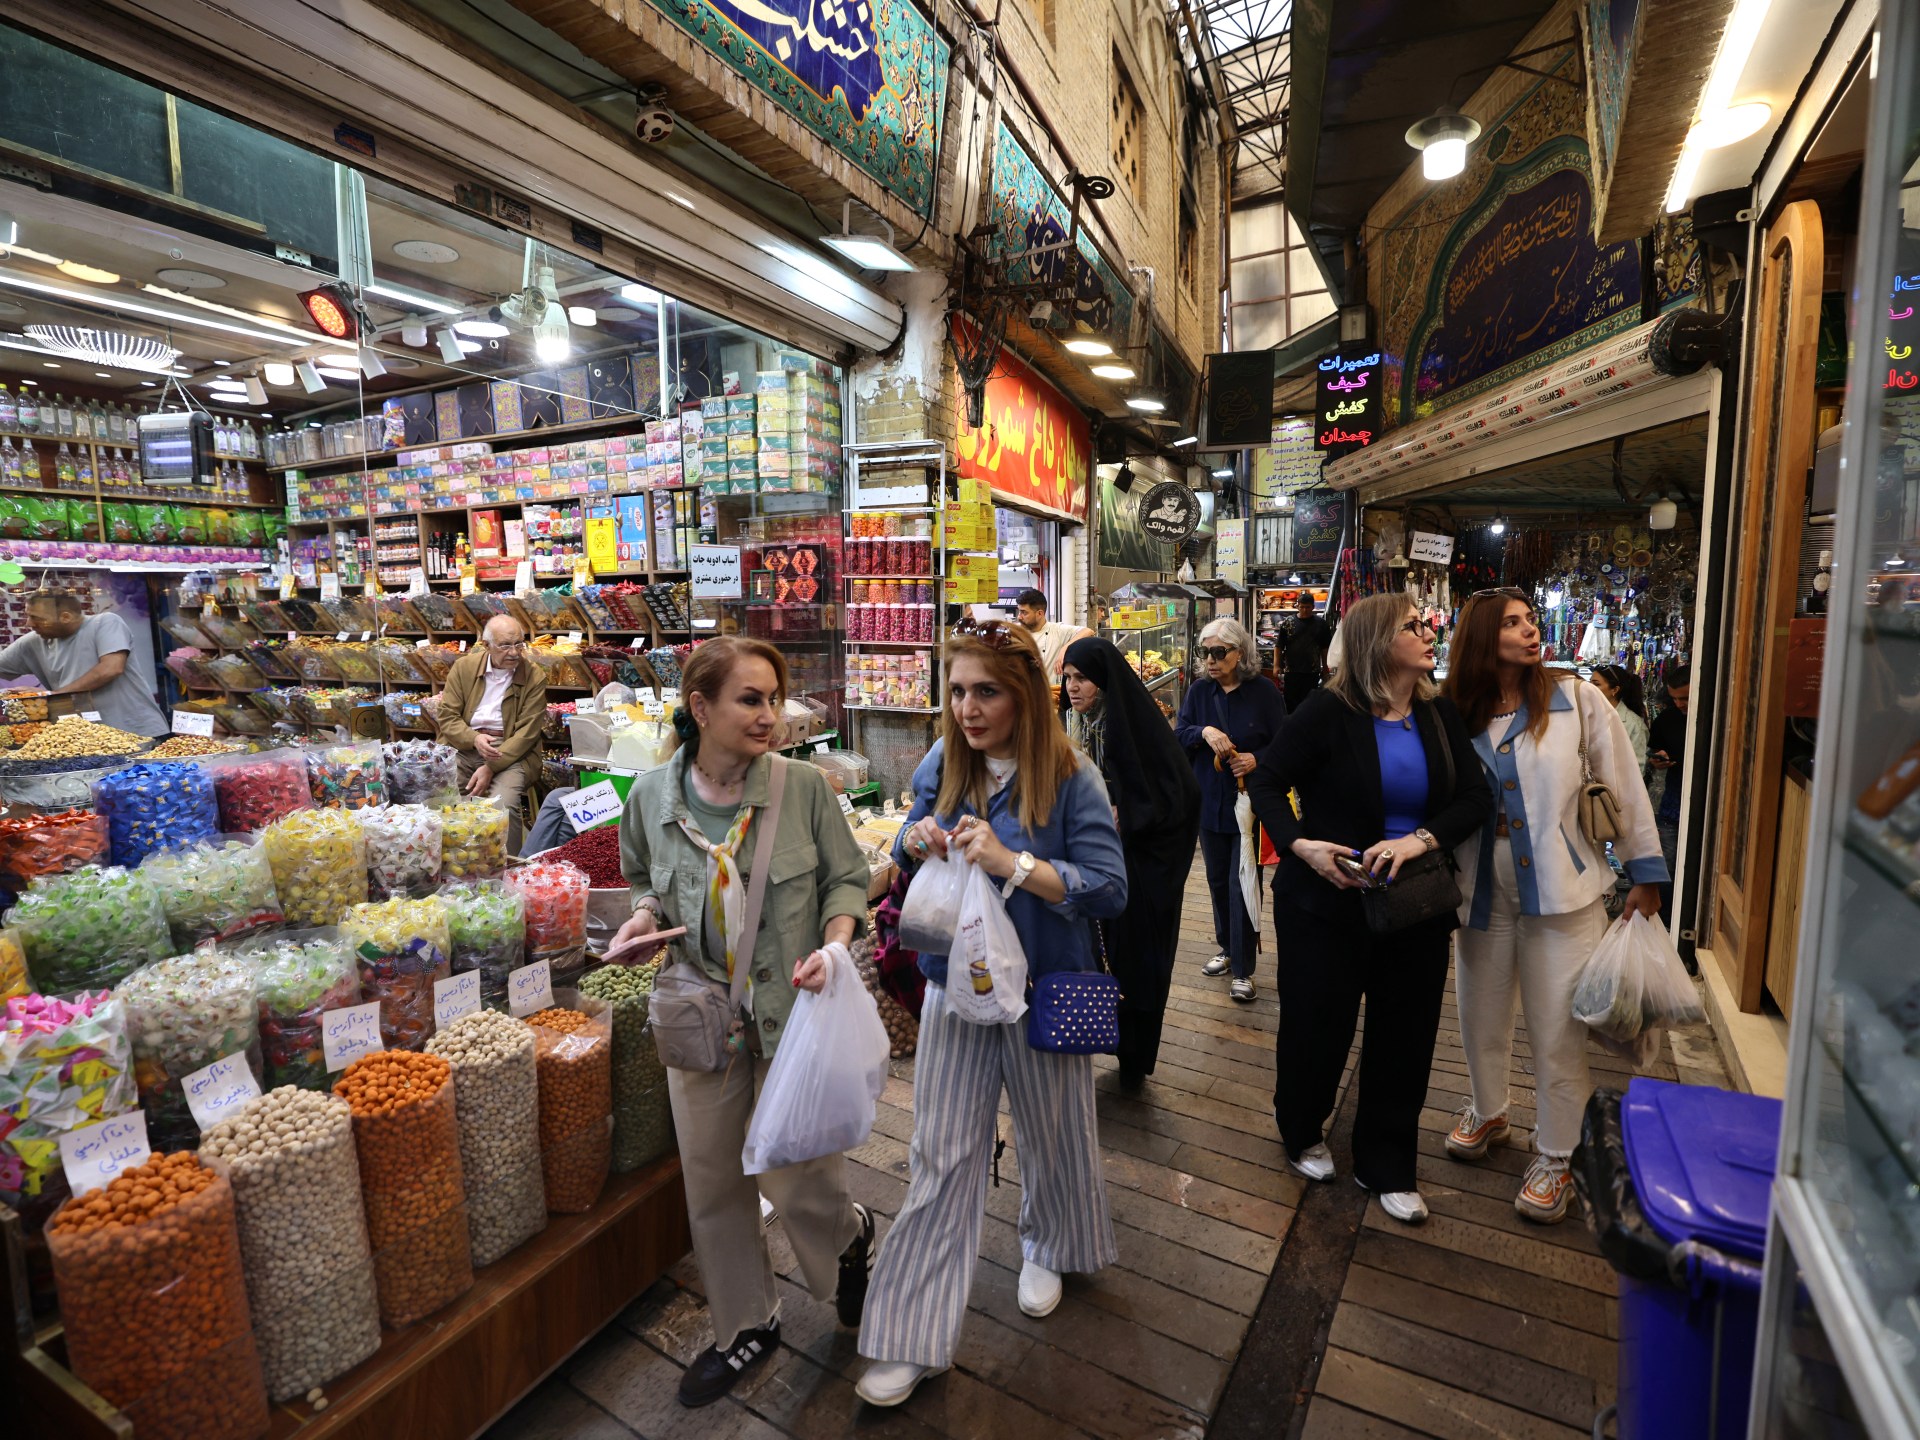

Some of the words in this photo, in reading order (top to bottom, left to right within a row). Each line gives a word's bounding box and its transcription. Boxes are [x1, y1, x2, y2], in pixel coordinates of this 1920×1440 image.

[1319, 354, 1380, 372] تعمیرات
[1566, 357, 1598, 376] NEWTECH
[1327, 372, 1369, 392] کیف
[1583, 365, 1616, 386] NEWTECH
[1537, 387, 1565, 405] NEWTECH
[1326, 398, 1368, 421] کفش
[1029, 390, 1055, 487] داغ
[1272, 436, 1293, 444] چمدا
[1320, 427, 1372, 445] چمدان
[1167, 526, 1186, 534] لقمه
[1298, 526, 1339, 548] کفش
[693, 554, 705, 565] جات
[707, 555, 721, 566] ادویه
[722, 554, 738, 566] آسیاب
[695, 574, 711, 584] مشتری
[712, 574, 731, 584] حضوری
[733, 576, 739, 584] در
[595, 788, 614, 798] زرشک
[98, 1138, 141, 1174] فلفلی
